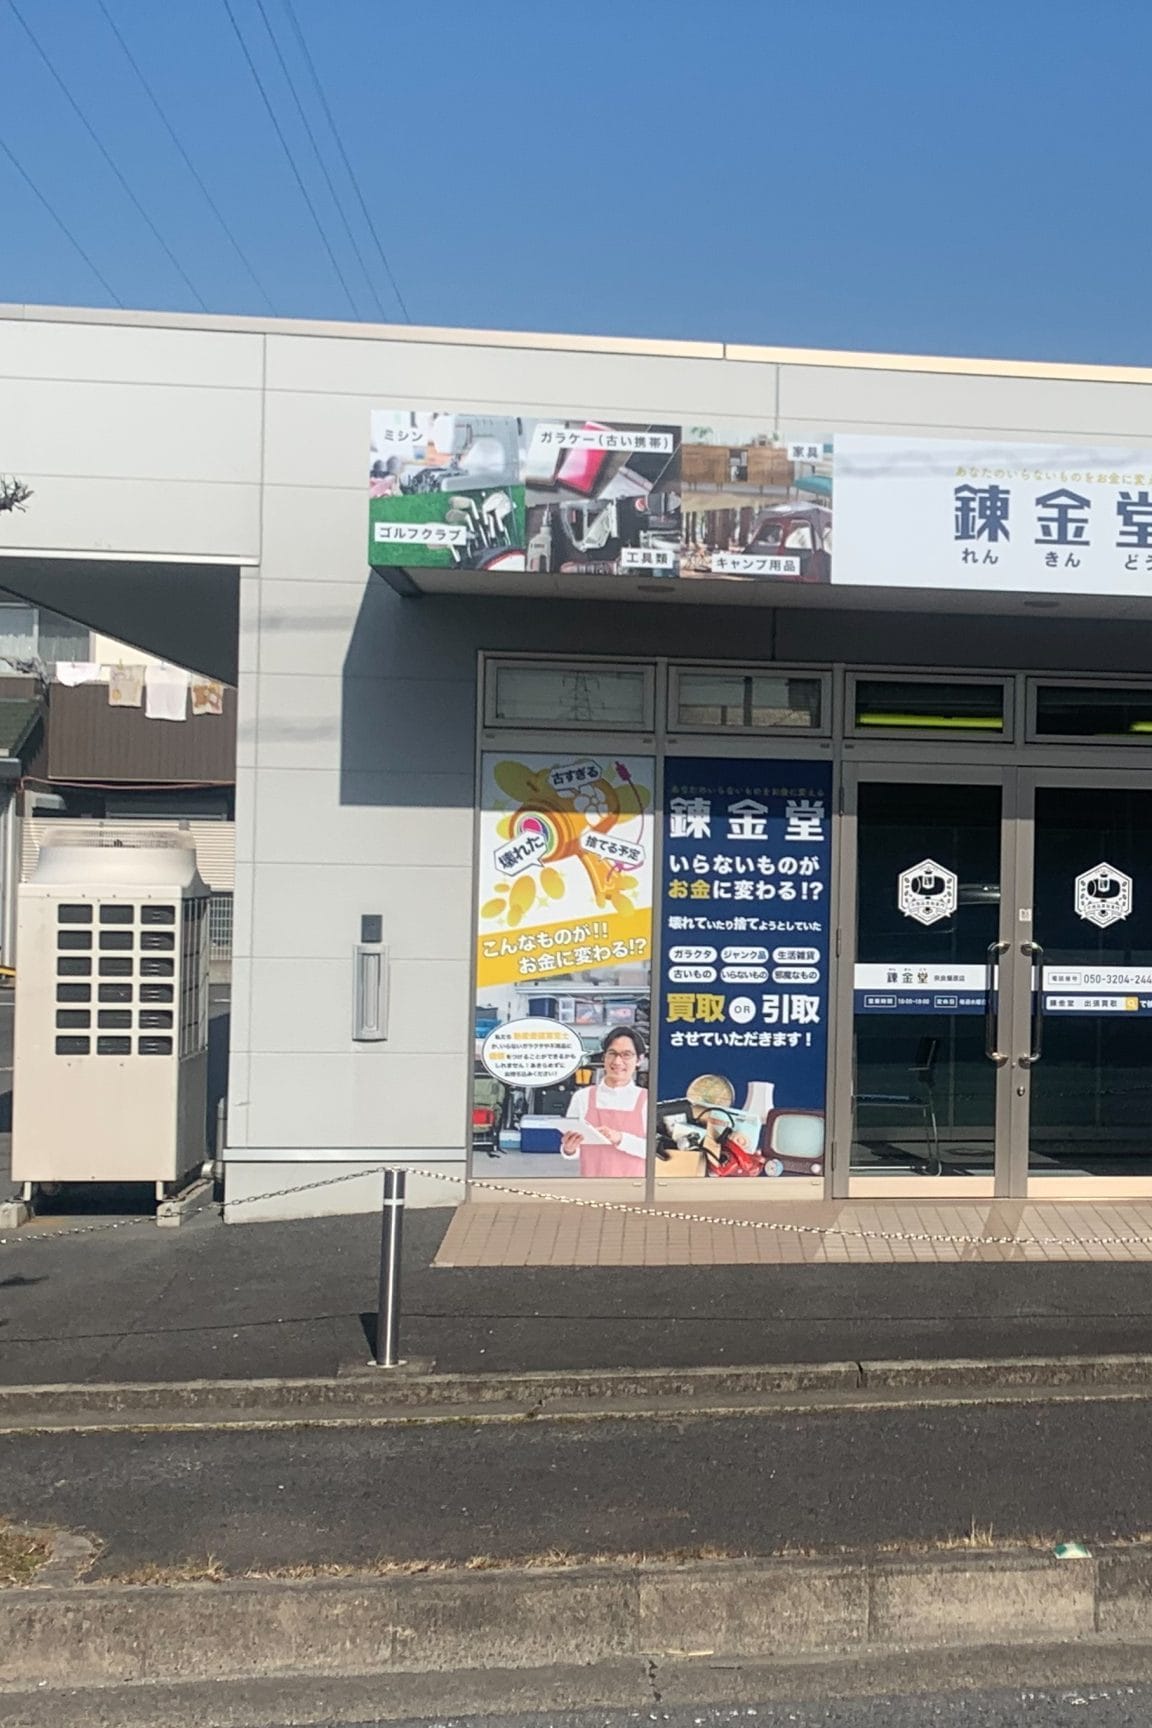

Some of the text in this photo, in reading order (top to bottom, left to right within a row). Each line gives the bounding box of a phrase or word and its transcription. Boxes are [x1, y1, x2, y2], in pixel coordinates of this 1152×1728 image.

[384, 429, 423, 443] ミシン
[793, 445, 819, 459] 家具
[379, 526, 463, 542] ゴルフクラブ
[626, 551, 669, 566] 工具類
[716, 557, 796, 572] キャンプ用品
[962, 548, 998, 564] れん
[1045, 551, 1081, 567] きん
[551, 765, 600, 784] 古すぎる
[670, 797, 825, 841] 錬金堂
[498, 835, 545, 869] 壊れた
[585, 835, 641, 861] 捨てる予定
[669, 854, 820, 876] いらないものが
[668, 916, 822, 932] 壊れていたり捨てようとしていた
[674, 950, 712, 959] ガラクタ
[723, 951, 767, 960] ジャンク品
[778, 951, 815, 960] 生活雑貨
[674, 969, 712, 978] 古いもの
[721, 971, 768, 979] いらないもの
[666, 992, 820, 1024] 買取 OR 引取
[670, 1031, 812, 1047] させていただきます！
